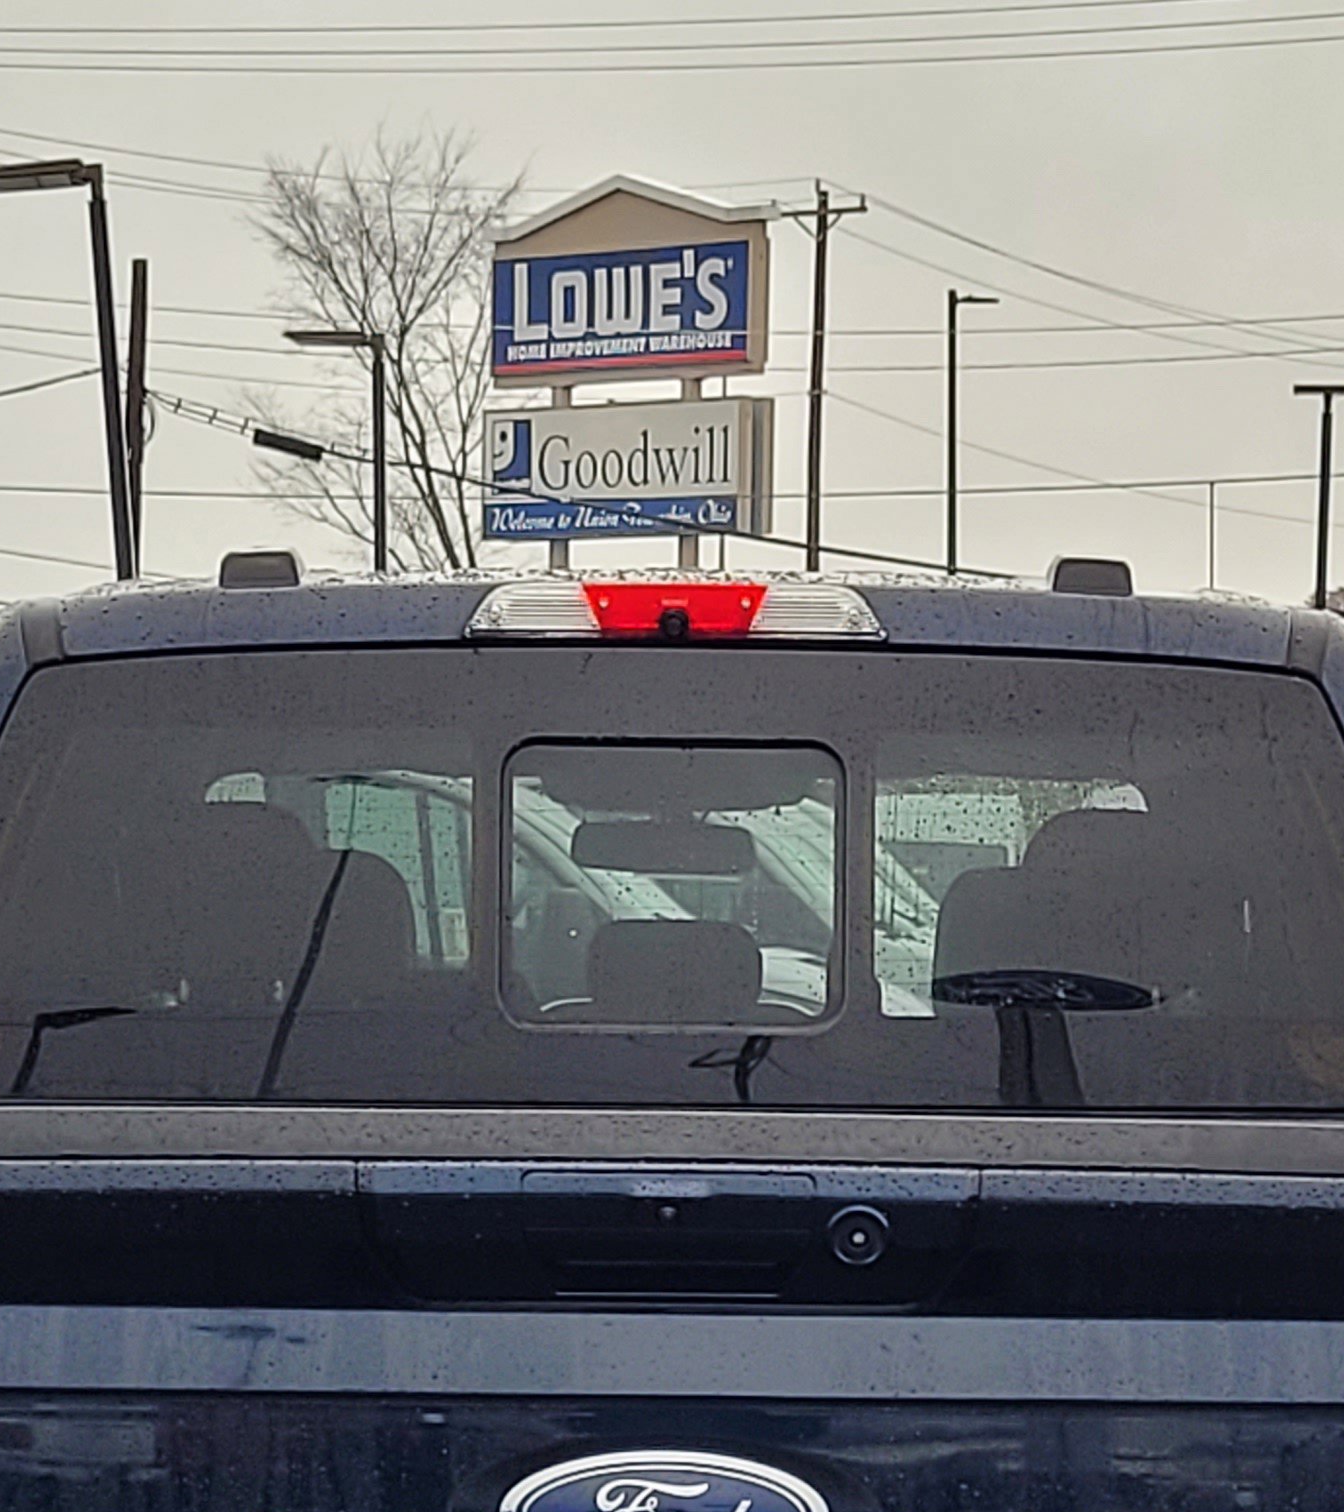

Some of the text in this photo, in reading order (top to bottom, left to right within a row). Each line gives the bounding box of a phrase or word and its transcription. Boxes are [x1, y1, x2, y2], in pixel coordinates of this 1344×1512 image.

[513, 249, 729, 342] LOWE'S
[507, 331, 733, 362] HOME IMPROVEMENT WAREHOUSE
[538, 424, 731, 491] Goodwill
